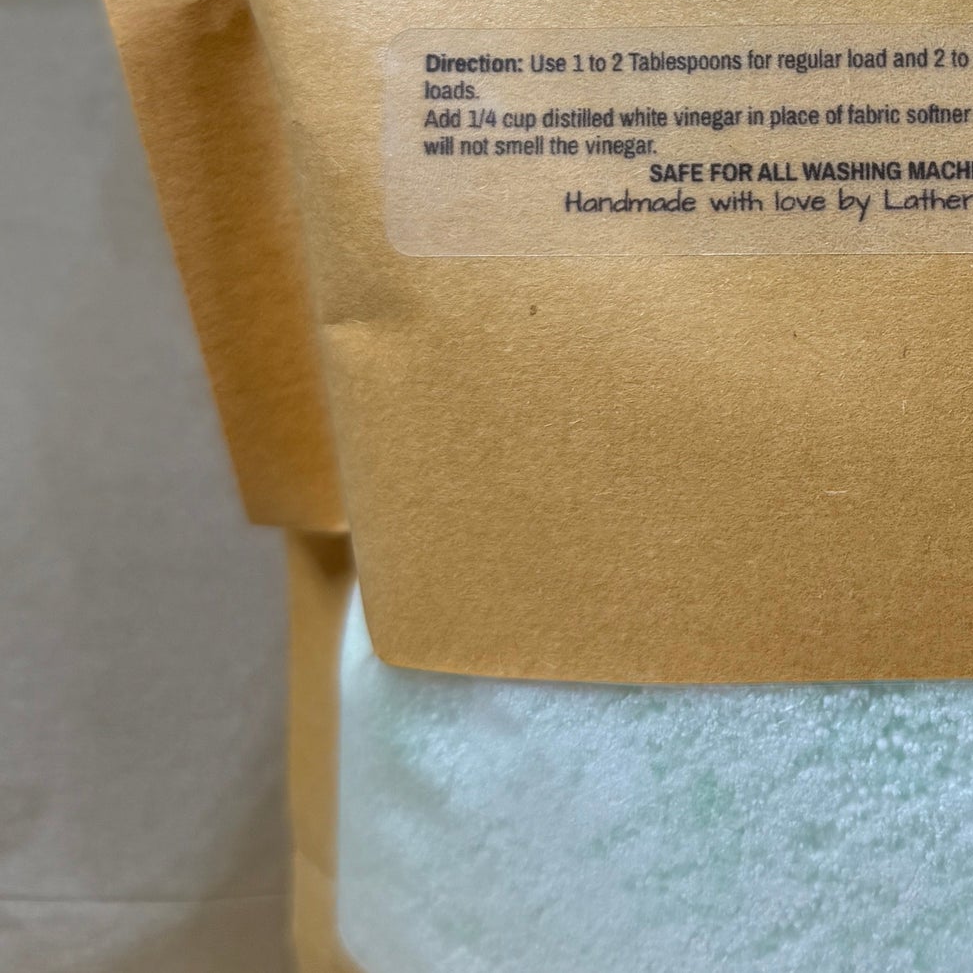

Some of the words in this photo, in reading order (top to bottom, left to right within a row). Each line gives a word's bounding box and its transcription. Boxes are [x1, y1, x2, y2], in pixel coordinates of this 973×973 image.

[425, 53, 523, 74] Direction:
[531, 54, 566, 73] Use
[573, 54, 584, 72] 1
[588, 54, 606, 72] to
[611, 53, 623, 72] 2
[628, 51, 742, 74] Tablespoons
[747, 51, 772, 70] for
[777, 50, 842, 73] regular
[847, 49, 886, 68] load
[892, 49, 928, 68] and
[934, 48, 946, 68] 2
[951, 48, 969, 67] to
[425, 80, 480, 100] loads.
[425, 108, 461, 128] Add
[468, 108, 496, 128] 1/4
[502, 112, 537, 132] cup
[542, 107, 614, 127] distilled
[619, 107, 668, 126] white
[674, 107, 743, 130] vinegar
[747, 106, 765, 125] in
[769, 106, 819, 128] place
[825, 105, 843, 124] of
[847, 104, 900, 124] fabric
[907, 104, 971, 124] softner
[425, 137, 454, 156] will
[461, 137, 489, 156] not
[494, 136, 544, 156] smell
[549, 136, 579, 155] the
[585, 136, 657, 159] vinegar.
[650, 163, 703, 183] SAFE
[710, 163, 753, 182] FOR
[758, 162, 797, 182] ALL
[802, 161, 902, 181] WASHING
[566, 190, 696, 214] Handmade
[711, 191, 763, 212] with
[774, 190, 826, 211] love
[838, 187, 871, 222] by
